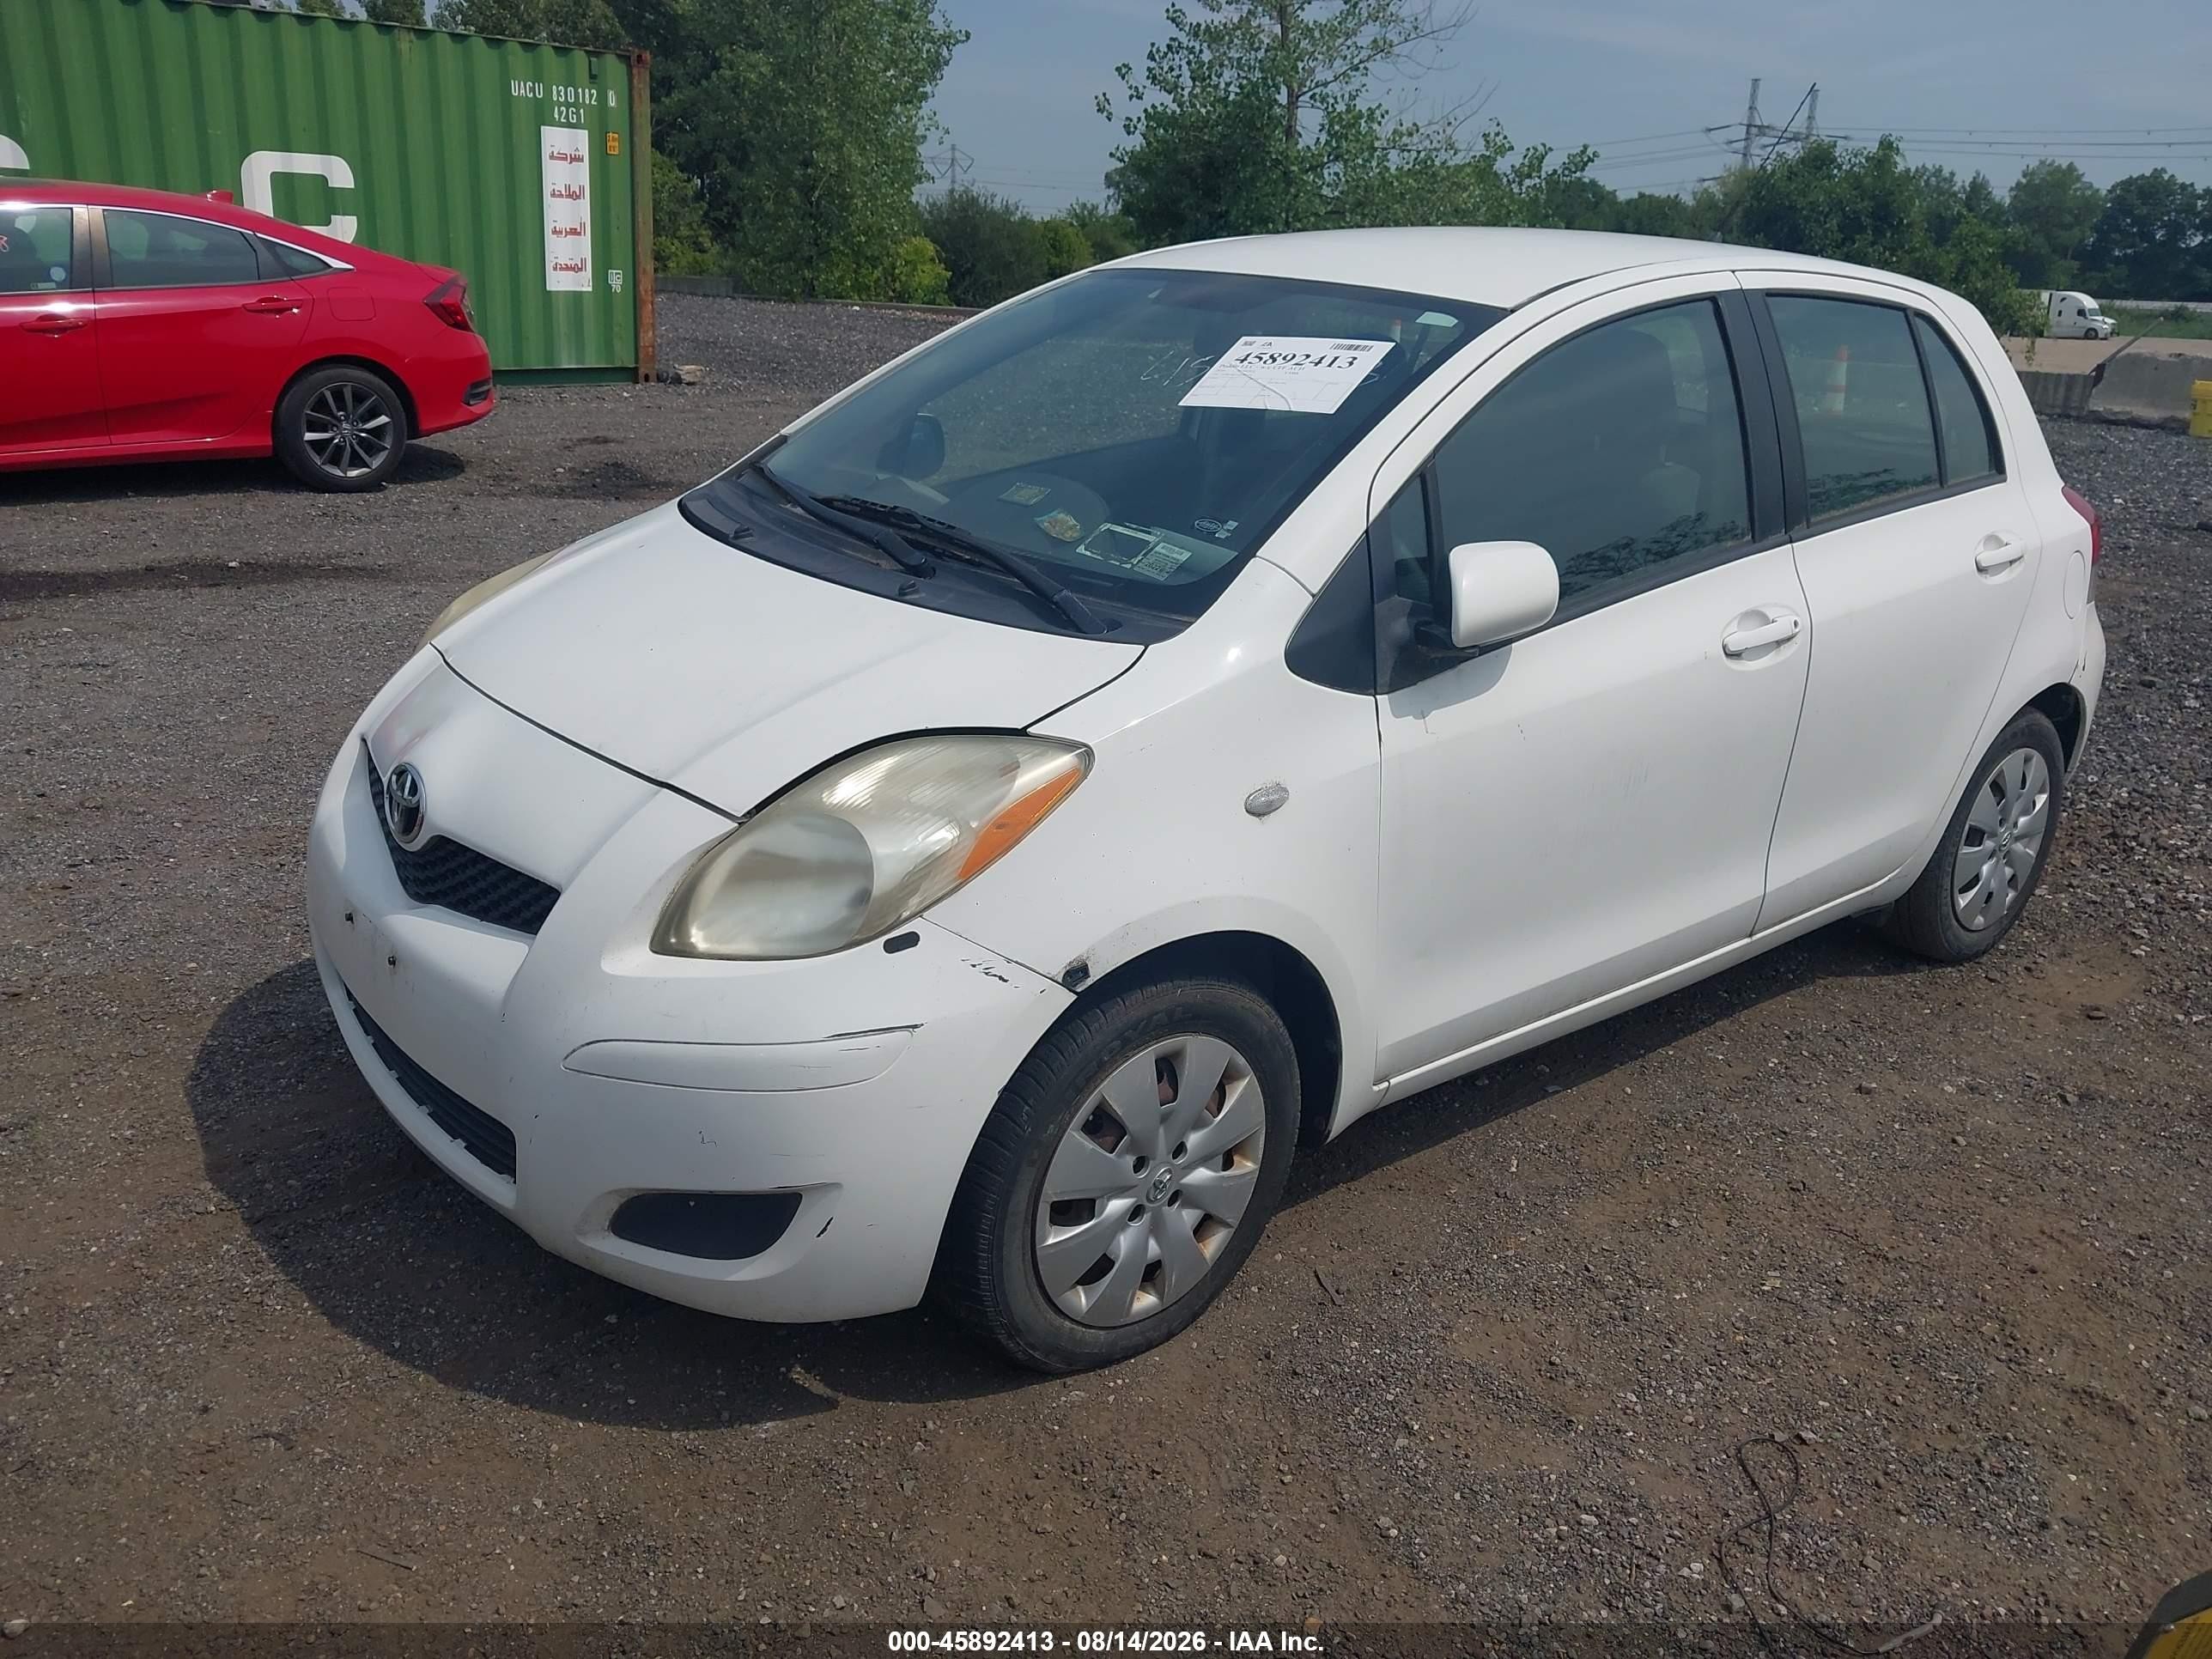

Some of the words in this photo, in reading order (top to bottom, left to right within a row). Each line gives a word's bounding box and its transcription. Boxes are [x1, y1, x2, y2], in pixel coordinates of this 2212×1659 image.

[511, 79, 544, 99] UACU
[552, 84, 598, 105] 830182
[554, 106, 585, 124] 42G1
[549, 144, 585, 165] شركة
[611, 284, 622, 294] 70
[1235, 351, 1358, 368] 45892413
